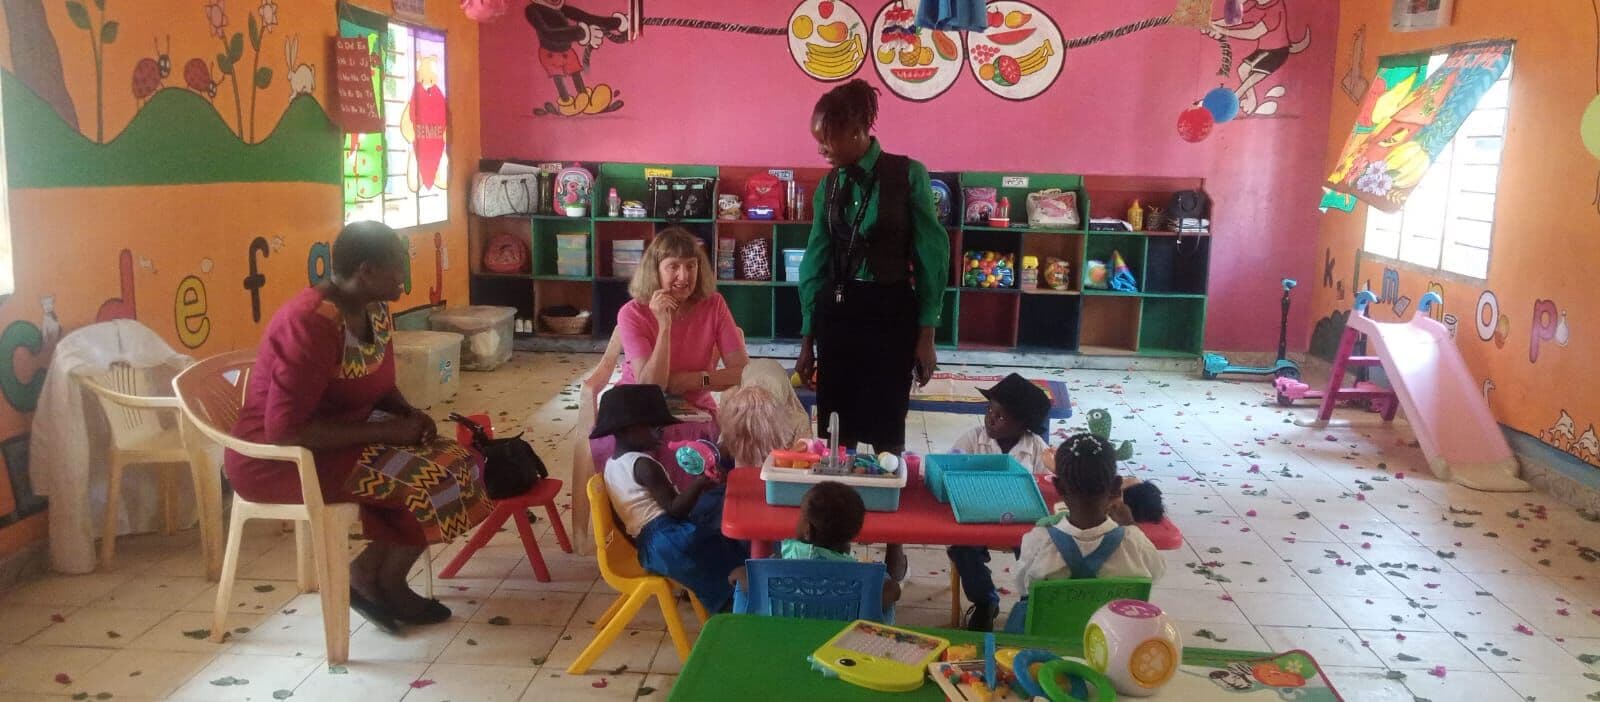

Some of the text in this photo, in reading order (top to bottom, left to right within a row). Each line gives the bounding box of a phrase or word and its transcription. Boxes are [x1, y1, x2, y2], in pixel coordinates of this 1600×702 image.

[174, 274, 211, 349] e
[243, 236, 270, 323] f
[1323, 248, 1335, 288] k
[1381, 267, 1400, 305] m
[1529, 298, 1558, 364] p
